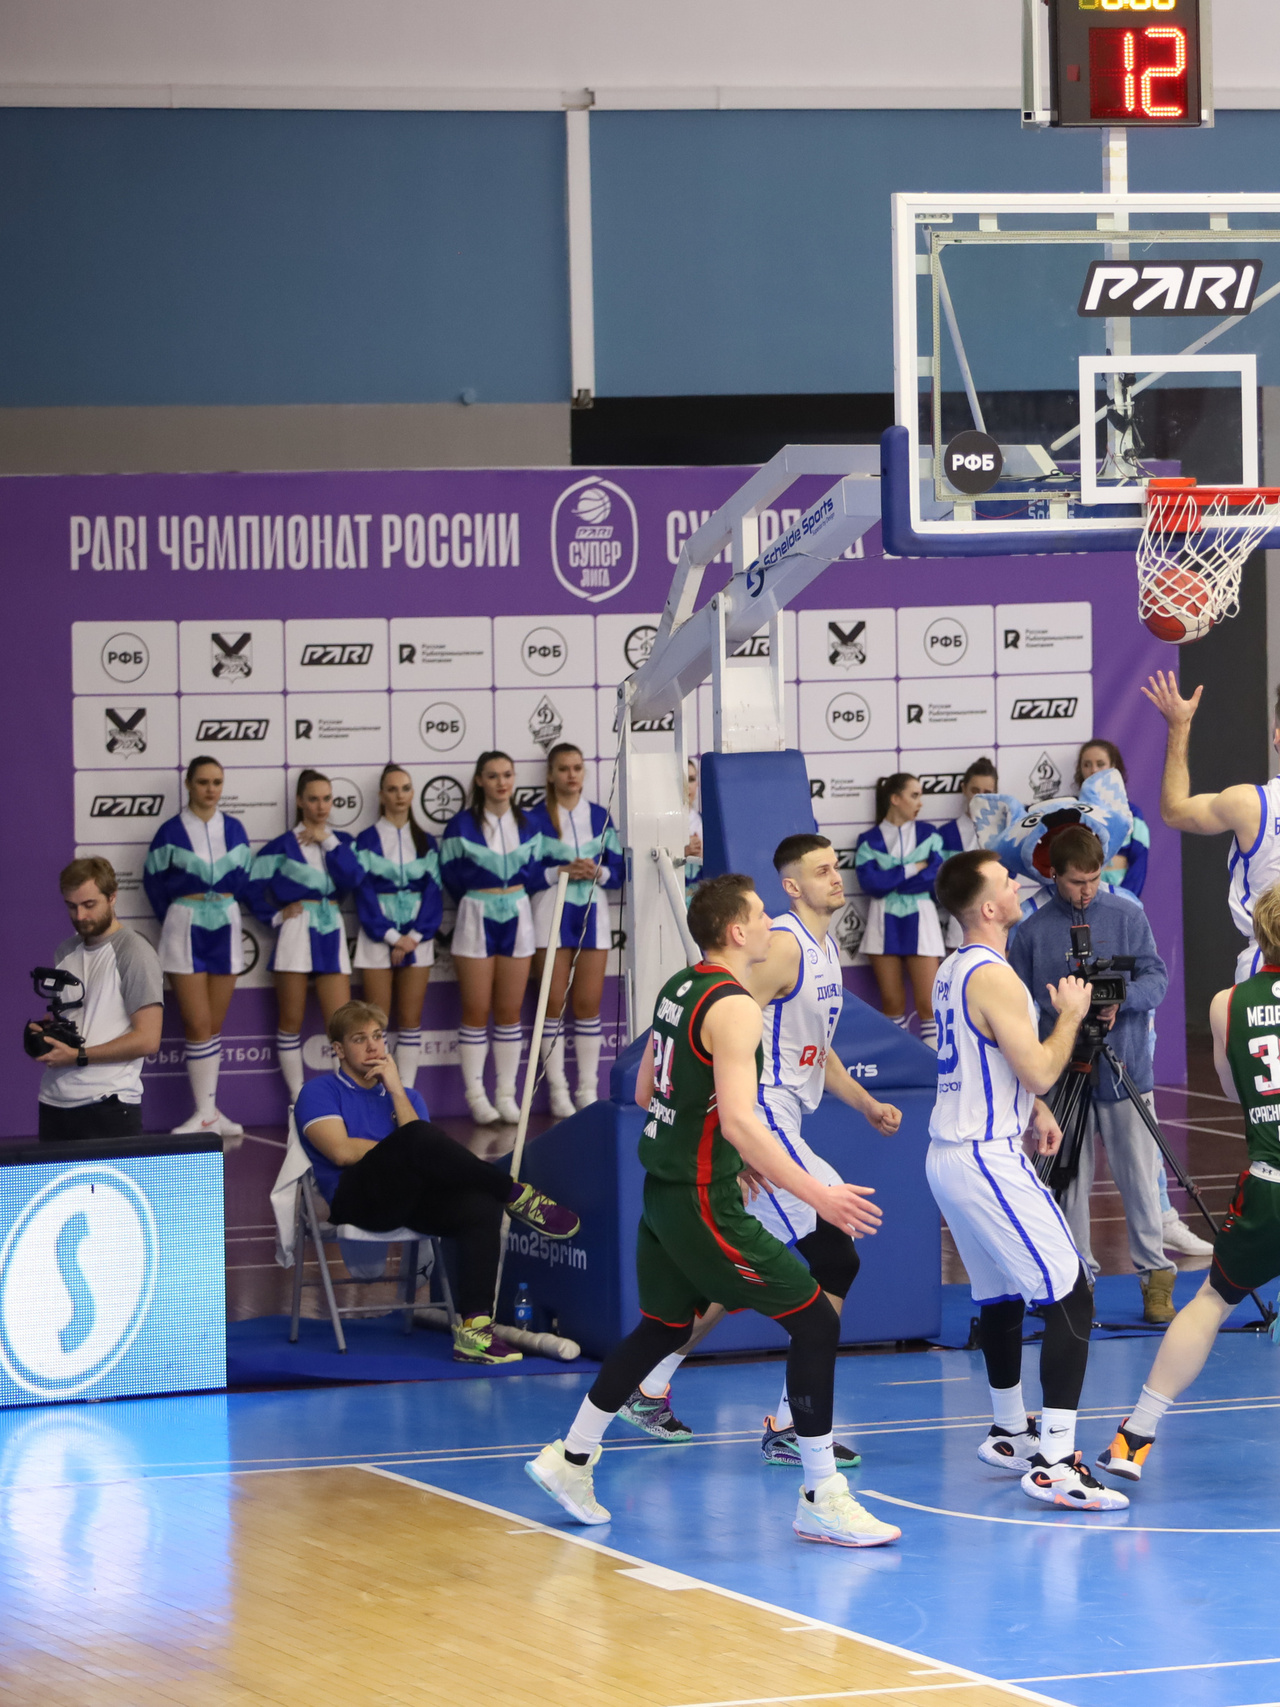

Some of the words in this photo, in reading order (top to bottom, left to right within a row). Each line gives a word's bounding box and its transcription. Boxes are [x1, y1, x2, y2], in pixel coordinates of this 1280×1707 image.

[1123, 27, 1186, 117] 12
[1084, 265, 1255, 311] PARI
[952, 454, 995, 471] РФБ
[763, 528, 801, 566] Schelde
[801, 497, 834, 535] Sports
[70, 515, 148, 571] PARI
[158, 513, 372, 570] ЧЕМПИОНАТ
[382, 513, 520, 569] РОССИИ
[568, 541, 622, 567] СУПЕР
[580, 568, 611, 588] ЛИГА
[930, 635, 963, 648] РФБ
[107, 651, 144, 664] РФБ
[303, 646, 371, 664] PARI
[527, 645, 562, 658] РФБ
[832, 710, 865, 723] РФБ
[1013, 699, 1076, 718] PARI
[199, 721, 267, 740] PARI
[425, 721, 460, 734] РФБ
[919, 775, 964, 793] PAR
[93, 796, 163, 815] PARI
[332, 795, 357, 809] ФБ
[847, 1062, 879, 1078] rts
[508, 1231, 587, 1270] mo25prim
